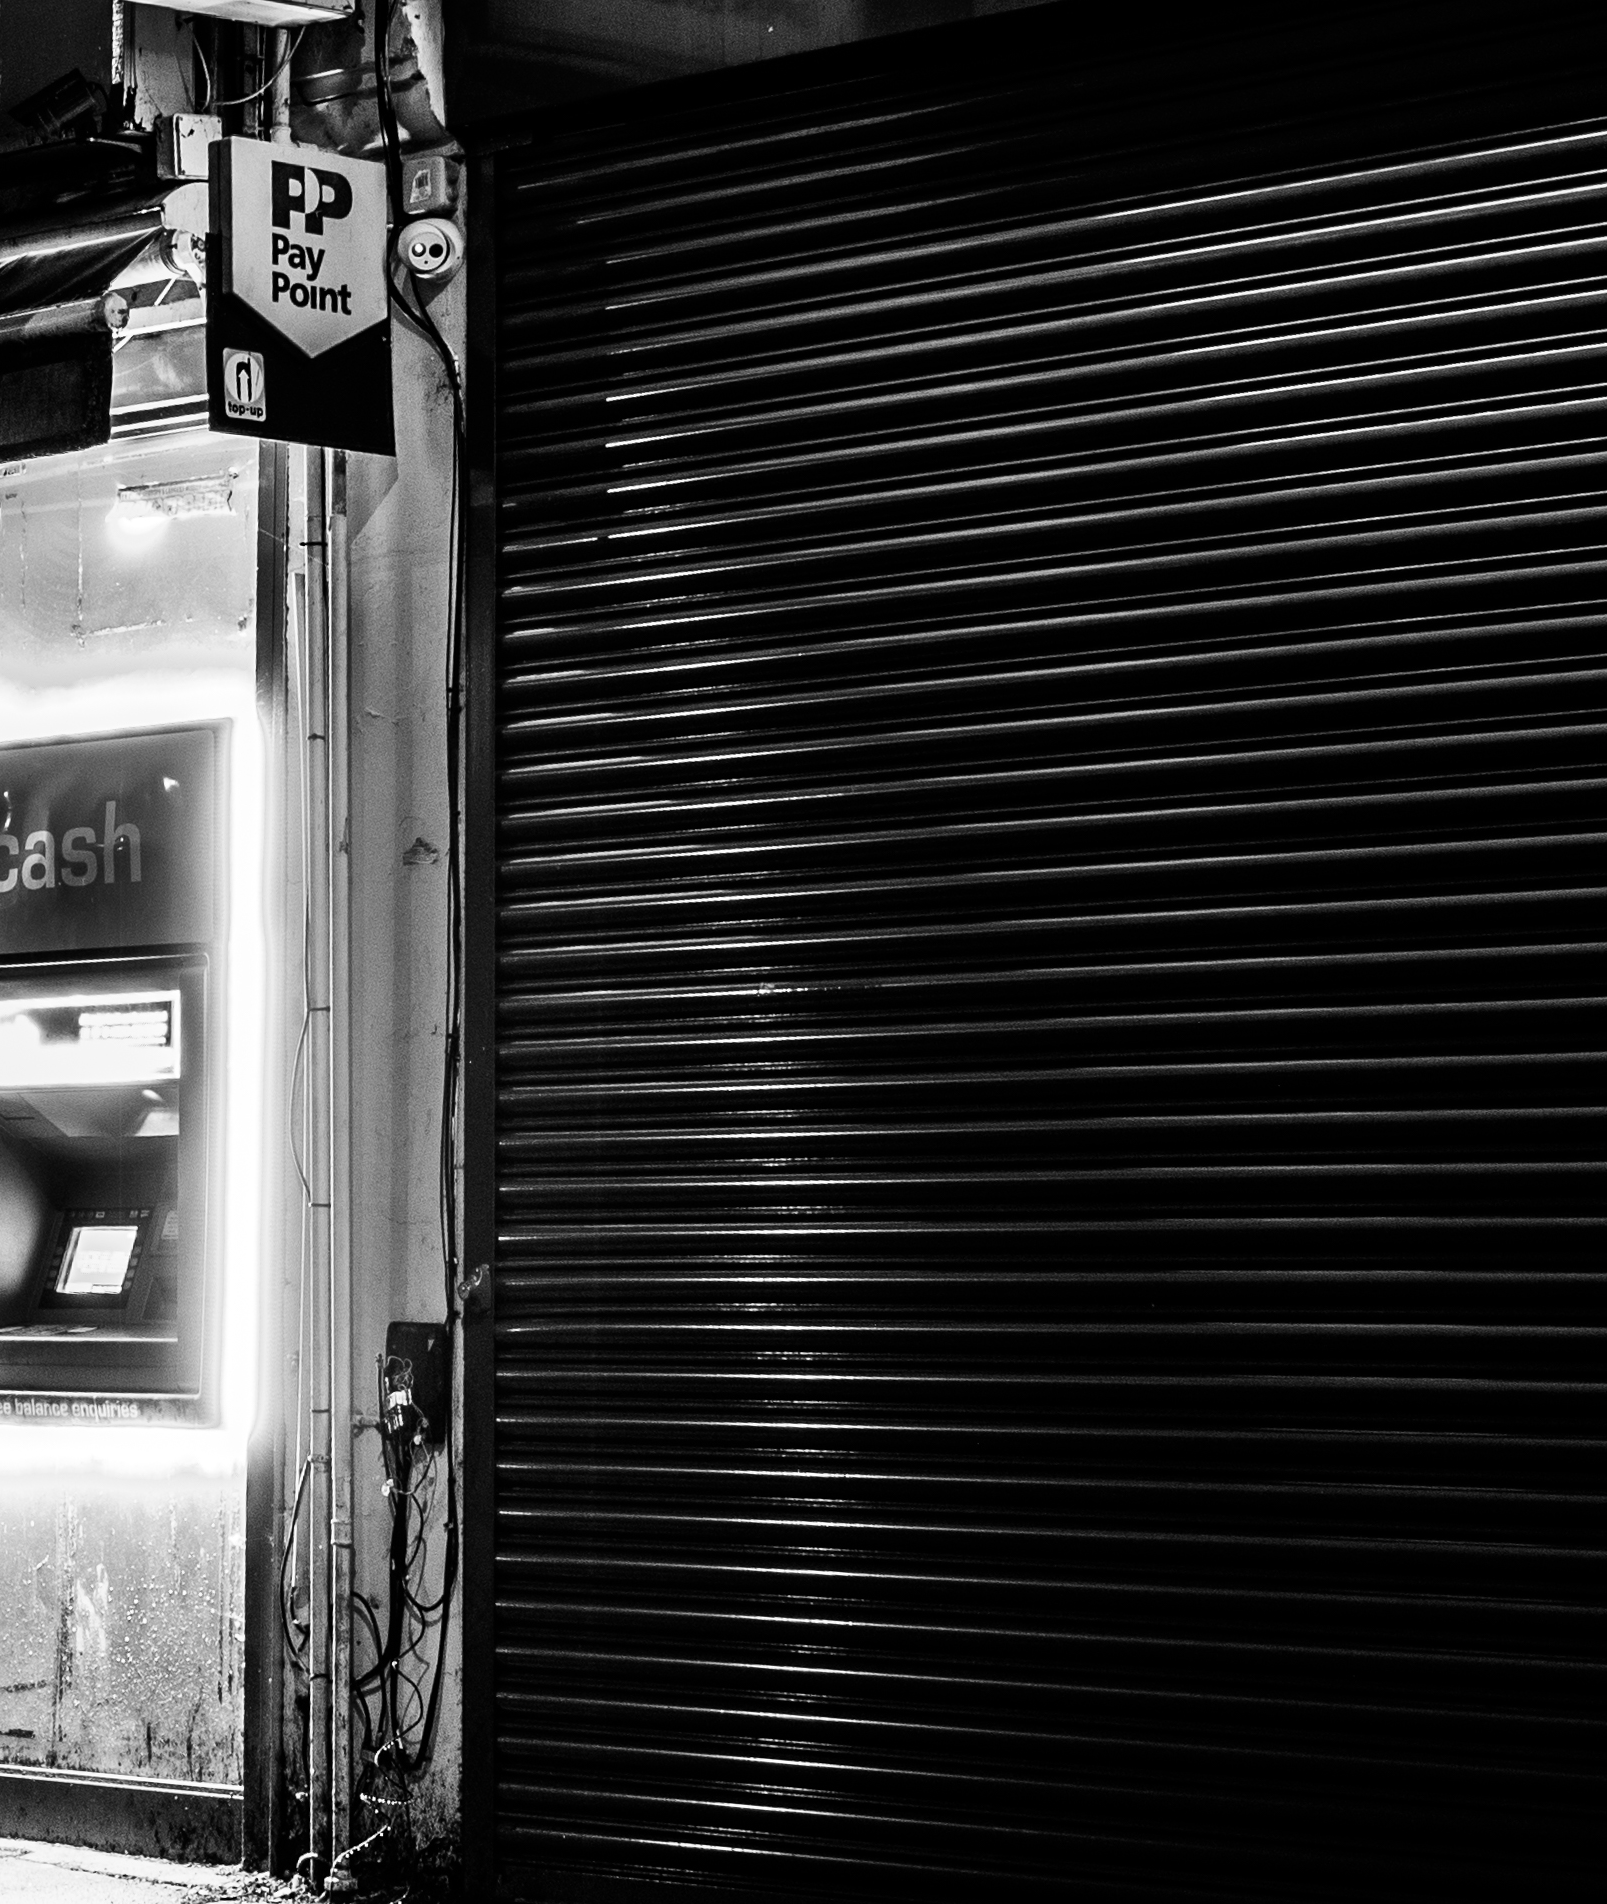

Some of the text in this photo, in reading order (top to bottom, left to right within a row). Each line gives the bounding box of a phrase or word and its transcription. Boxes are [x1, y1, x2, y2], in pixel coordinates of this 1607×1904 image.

[272, 232, 326, 281] Pay
[272, 270, 352, 316] Point
[227, 401, 264, 418] top-up
[14, 1398, 69, 1417] balance
[71, 1399, 139, 1422] enquiries
